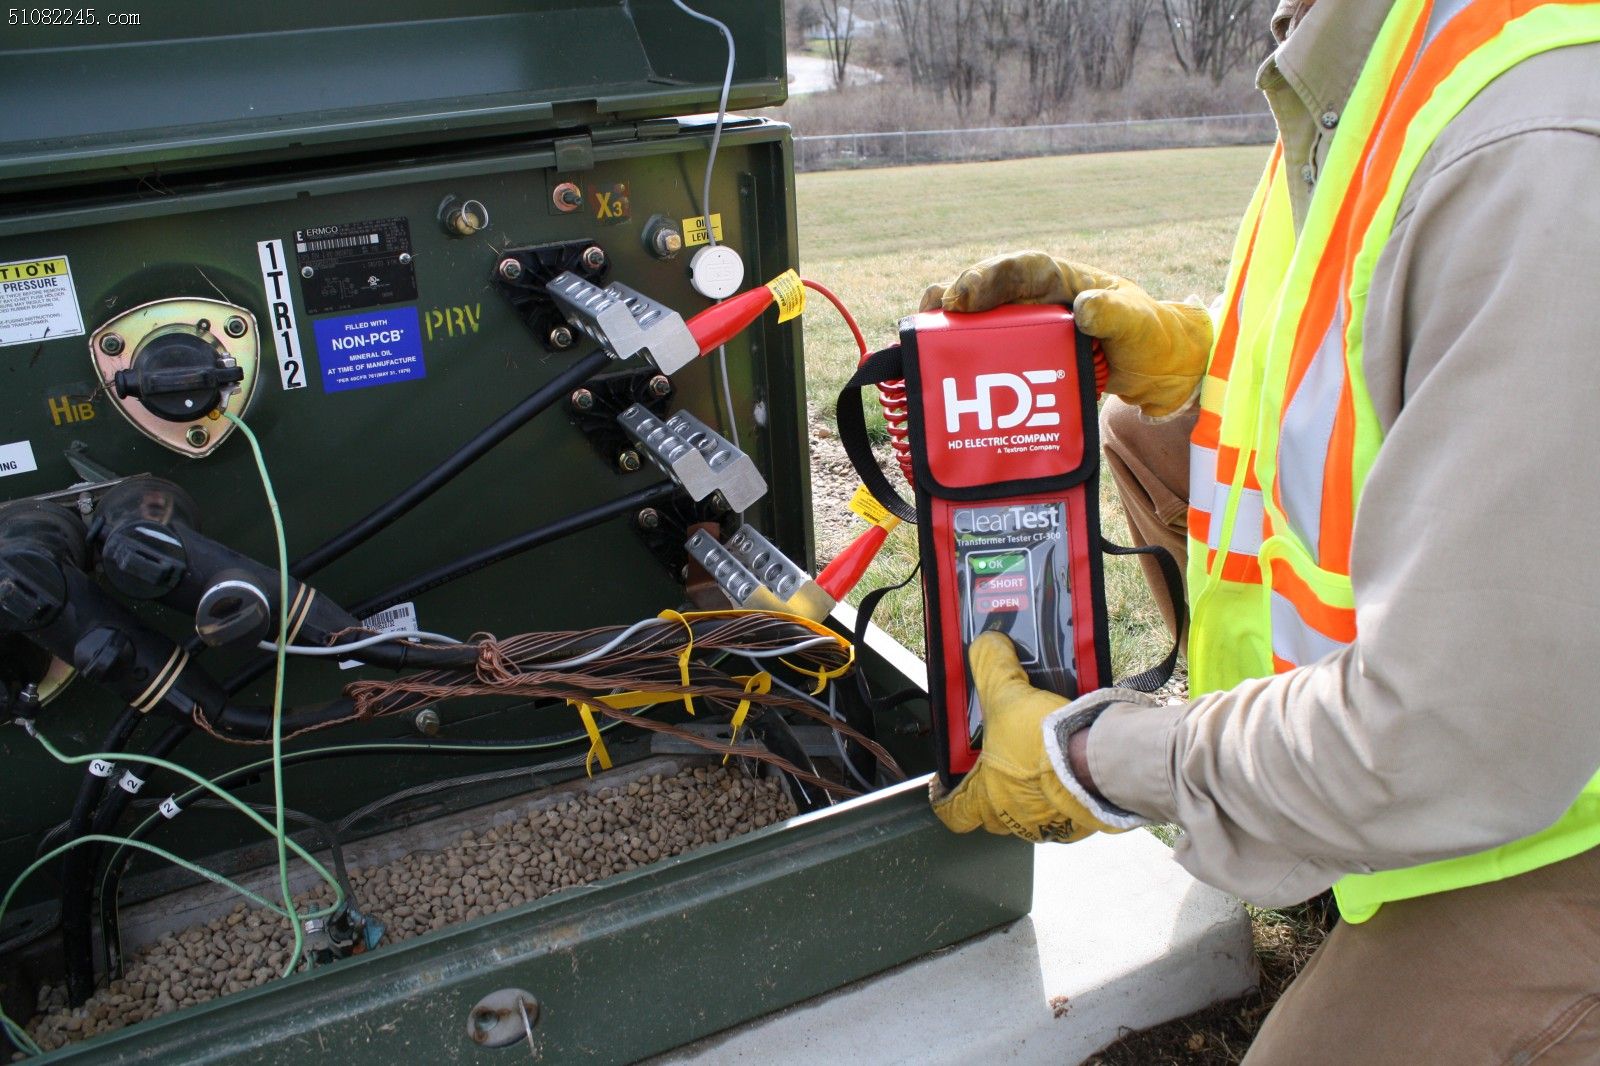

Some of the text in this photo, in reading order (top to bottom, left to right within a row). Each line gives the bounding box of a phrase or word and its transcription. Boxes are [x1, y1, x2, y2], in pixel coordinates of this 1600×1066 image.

[595, 192, 623, 219] X3
[306, 225, 338, 237] ERMCO
[3, 277, 58, 293] PRESSURE
[345, 319, 388, 331] FILLED WITH
[425, 303, 481, 341] PRV
[349, 351, 379, 361] MINERAL
[327, 368, 336, 376] AT
[337, 366, 354, 374] TIME
[366, 356, 417, 369] MANUFACTURE
[948, 433, 1060, 450] HD ELECTRIC COMPANY
[1004, 446, 1027, 454] Textron
[954, 506, 1060, 534] ClearTest
[957, 532, 1061, 547] Transformer Tester CT-300
[988, 561, 1004, 569] OK
[990, 578, 1024, 589] SHORT
[991, 598, 1019, 608] OPEN
[95, 762, 105, 772] 2
[127, 780, 138, 789] 2
[164, 802, 174, 813] 2
